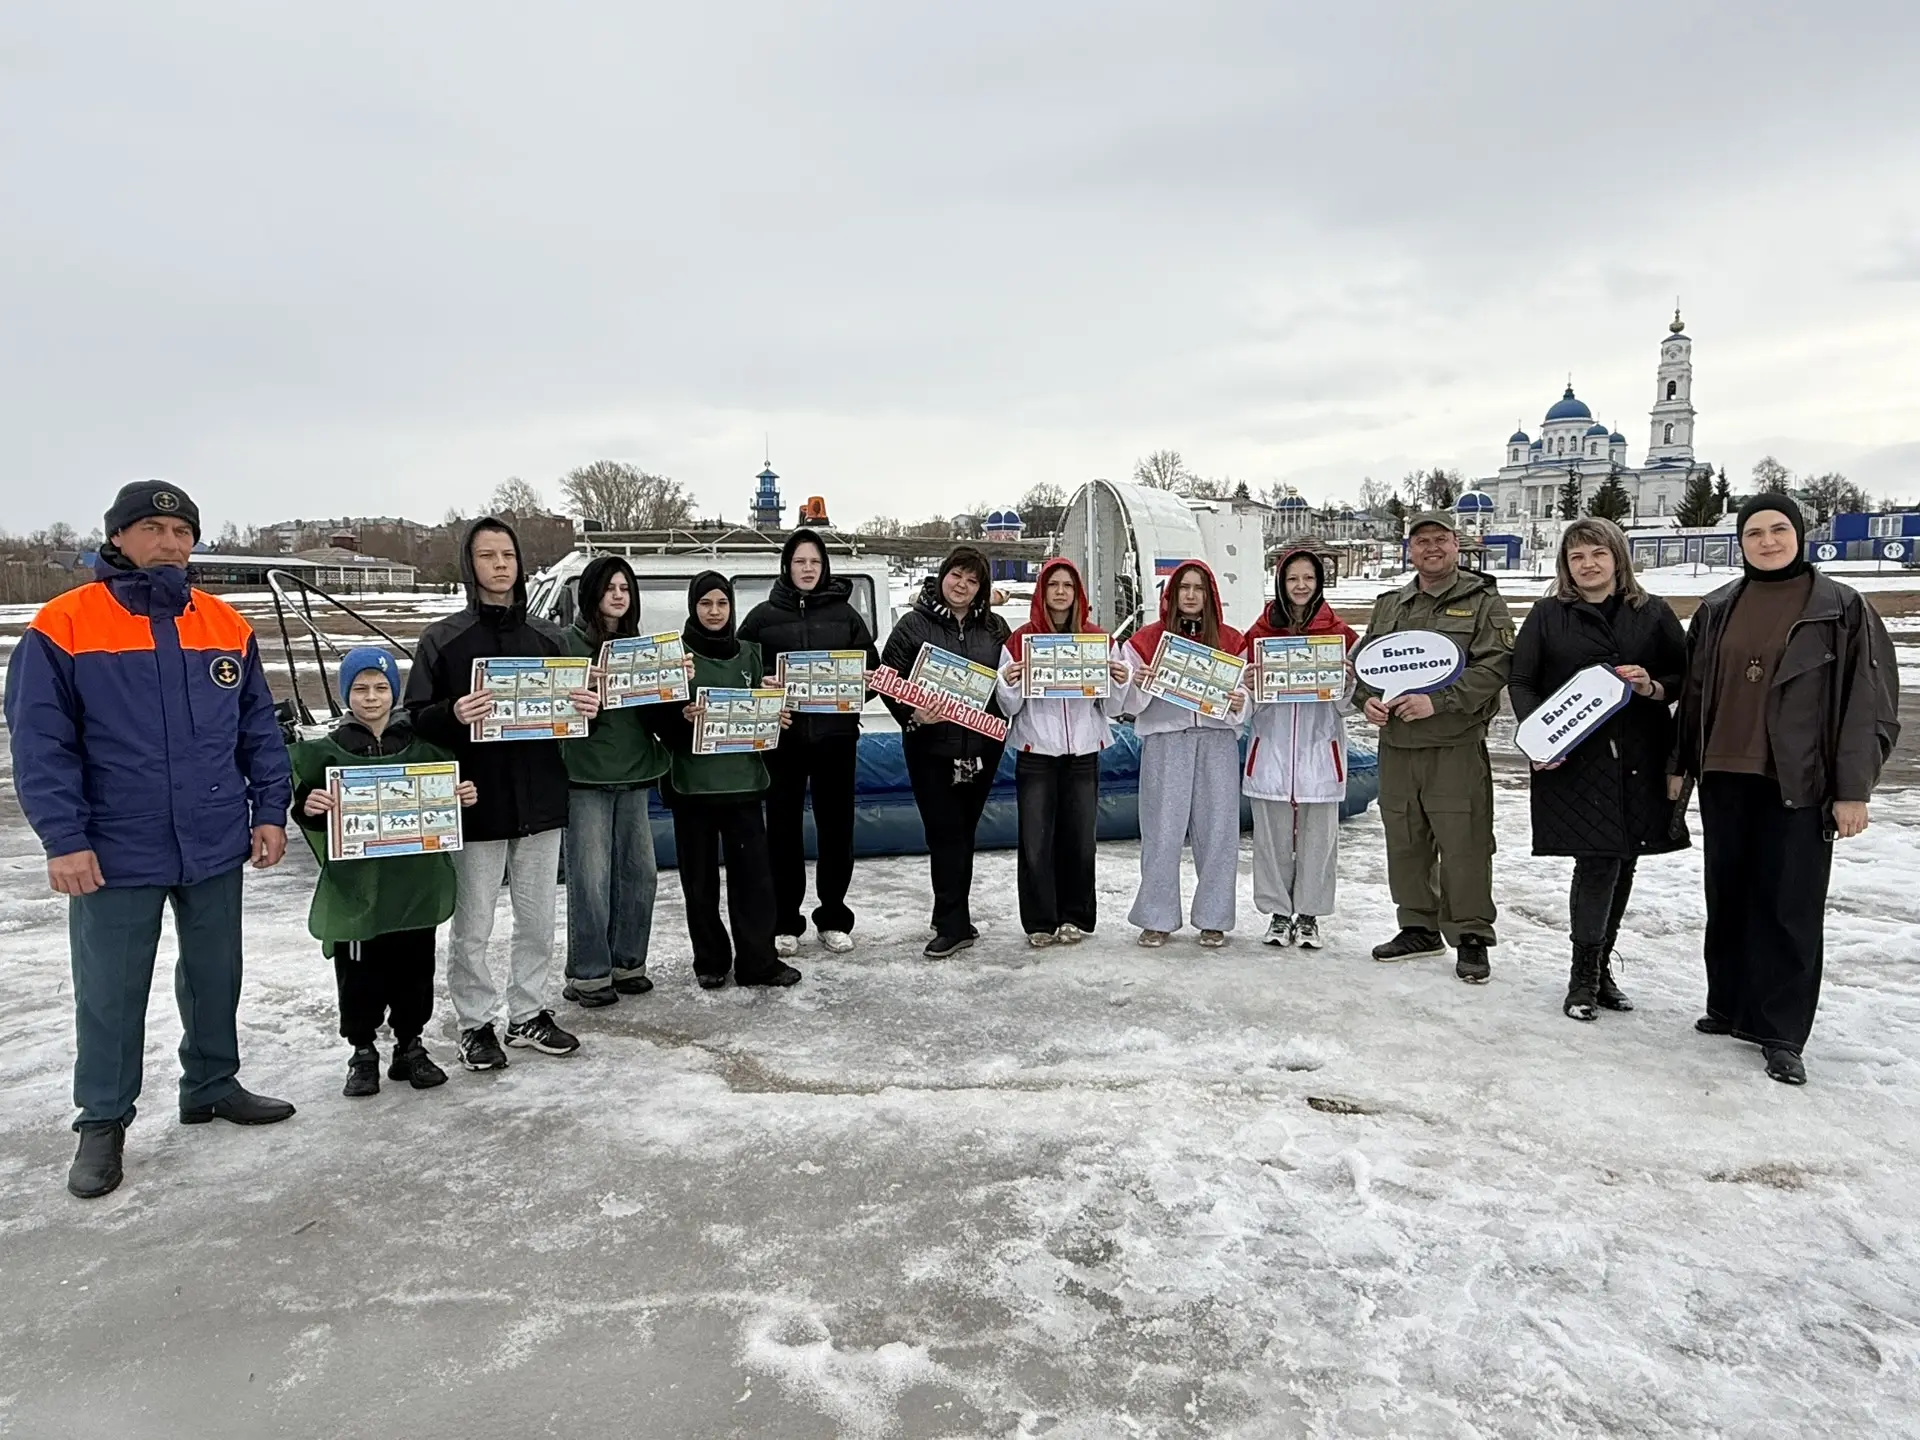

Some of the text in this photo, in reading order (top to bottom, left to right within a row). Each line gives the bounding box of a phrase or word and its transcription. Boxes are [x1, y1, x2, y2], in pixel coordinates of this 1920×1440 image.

[1382, 647, 1425, 658] Быть
[1361, 658, 1452, 675] человеком
[1540, 692, 1583, 726] Быть
[1548, 697, 1603, 744] вместе
